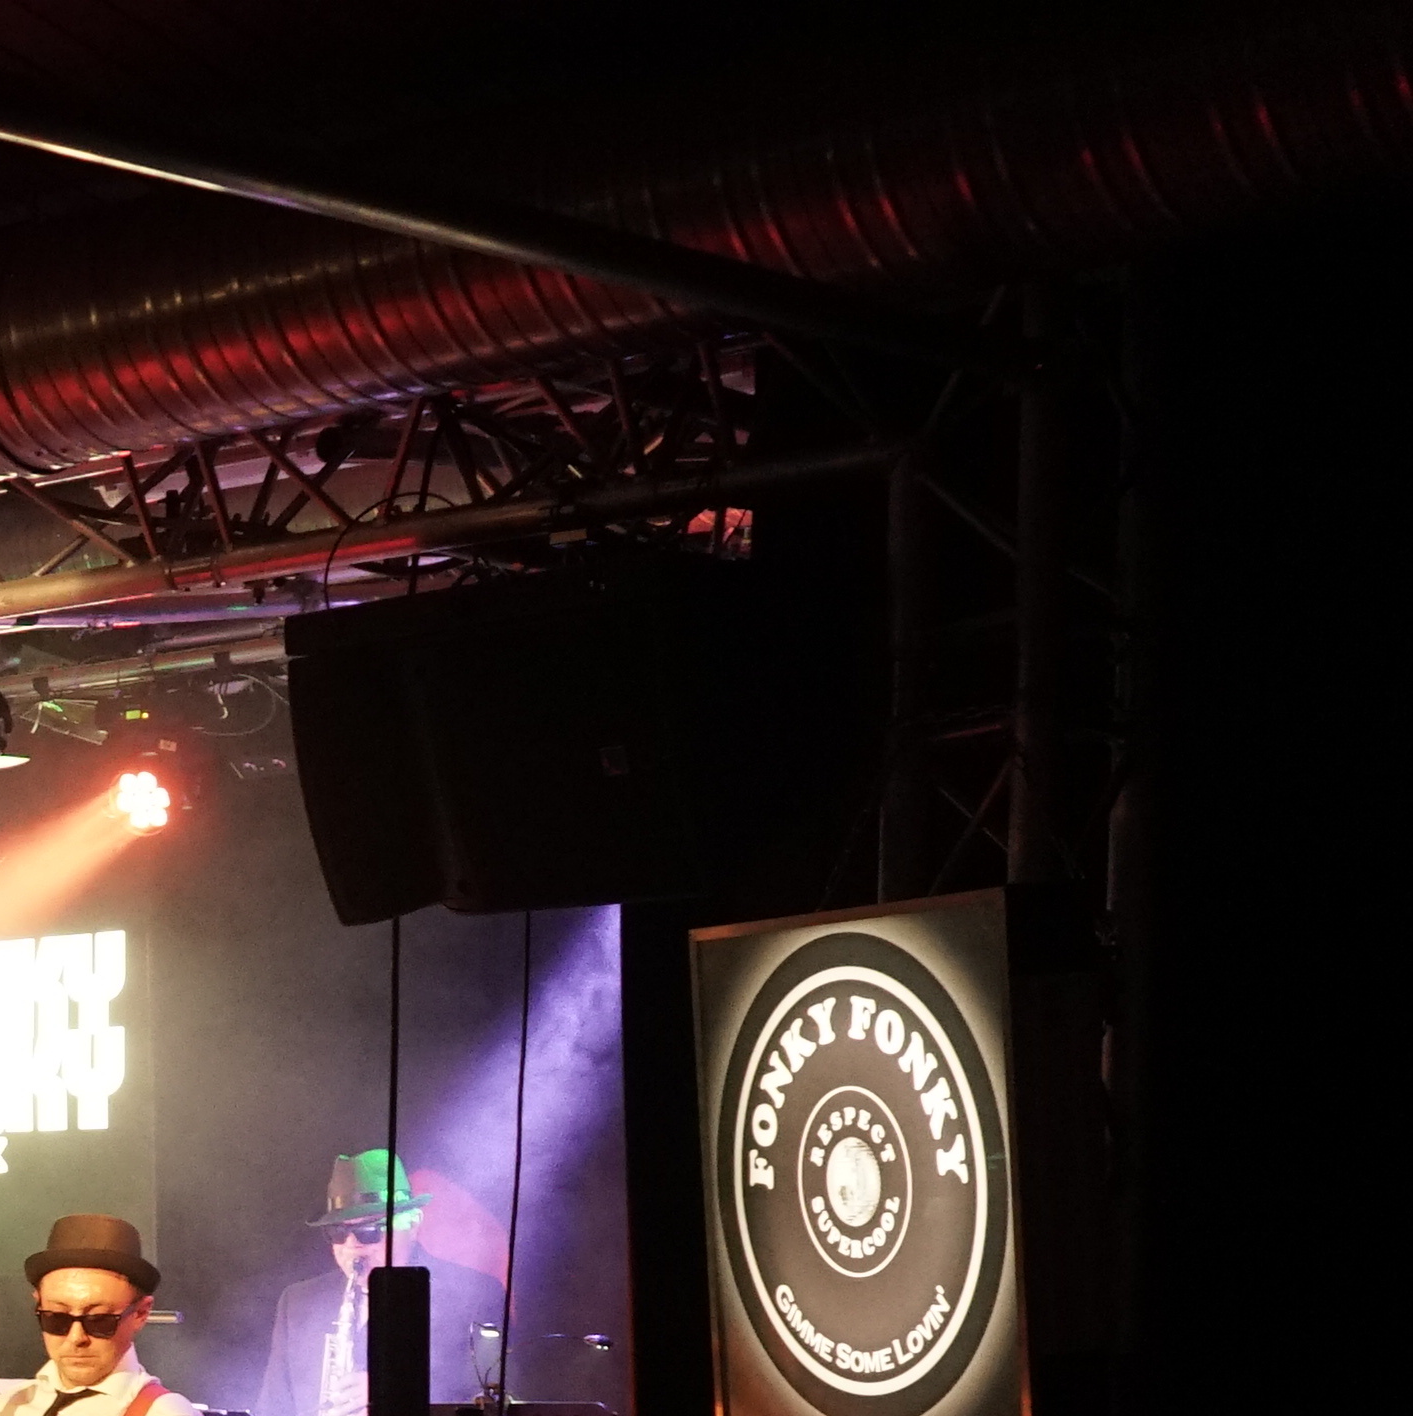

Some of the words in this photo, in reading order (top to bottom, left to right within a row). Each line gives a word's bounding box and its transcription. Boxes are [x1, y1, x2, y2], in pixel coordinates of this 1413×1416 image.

[748, 996, 837, 1191] FONKY
[847, 994, 970, 1185] FONKY
[809, 1106, 897, 1167] RESPECT
[811, 1196, 901, 1259] SUPERCOOL
[775, 1284, 835, 1363] GIMME
[835, 1342, 895, 1373] SOME
